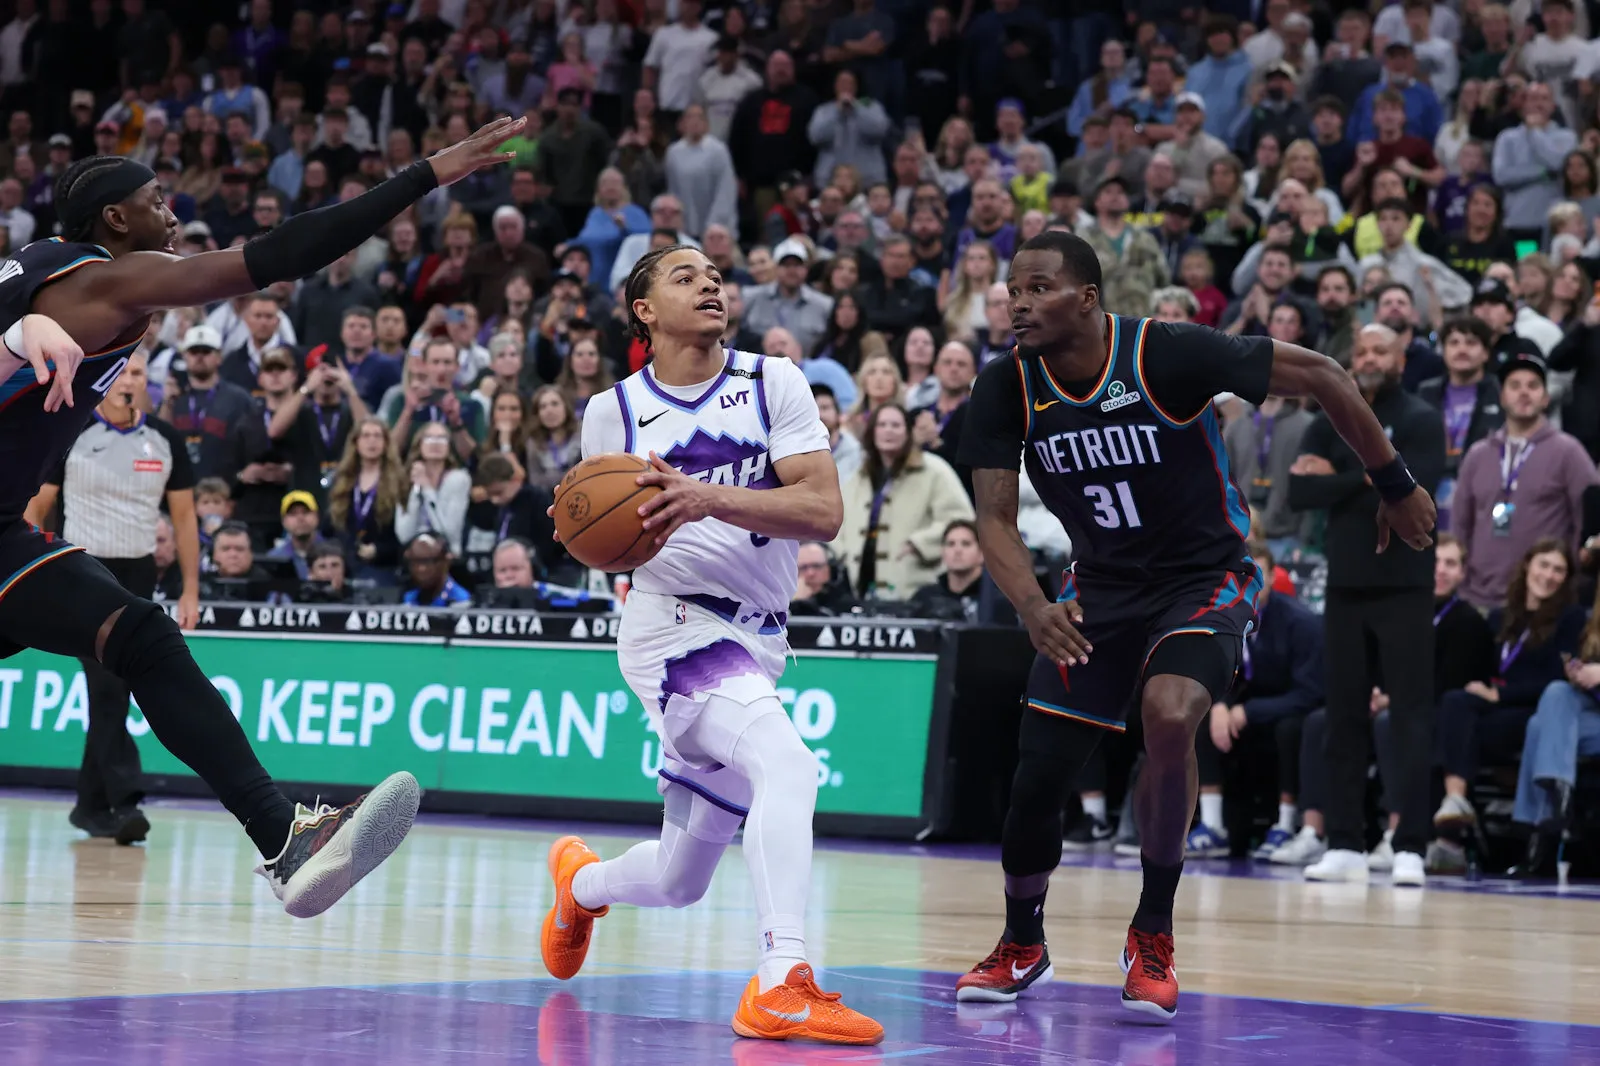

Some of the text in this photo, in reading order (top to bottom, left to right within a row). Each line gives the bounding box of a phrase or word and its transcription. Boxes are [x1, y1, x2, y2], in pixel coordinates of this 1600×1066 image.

[719, 390, 750, 409] LVT
[1034, 424, 1161, 473] DETROIT
[1083, 480, 1142, 529] 31
[258, 607, 321, 628] DELTA
[365, 610, 430, 631] DELTA
[476, 614, 543, 635] DELTA
[840, 625, 916, 648] DELTA
[257, 678, 396, 747] KEEP
